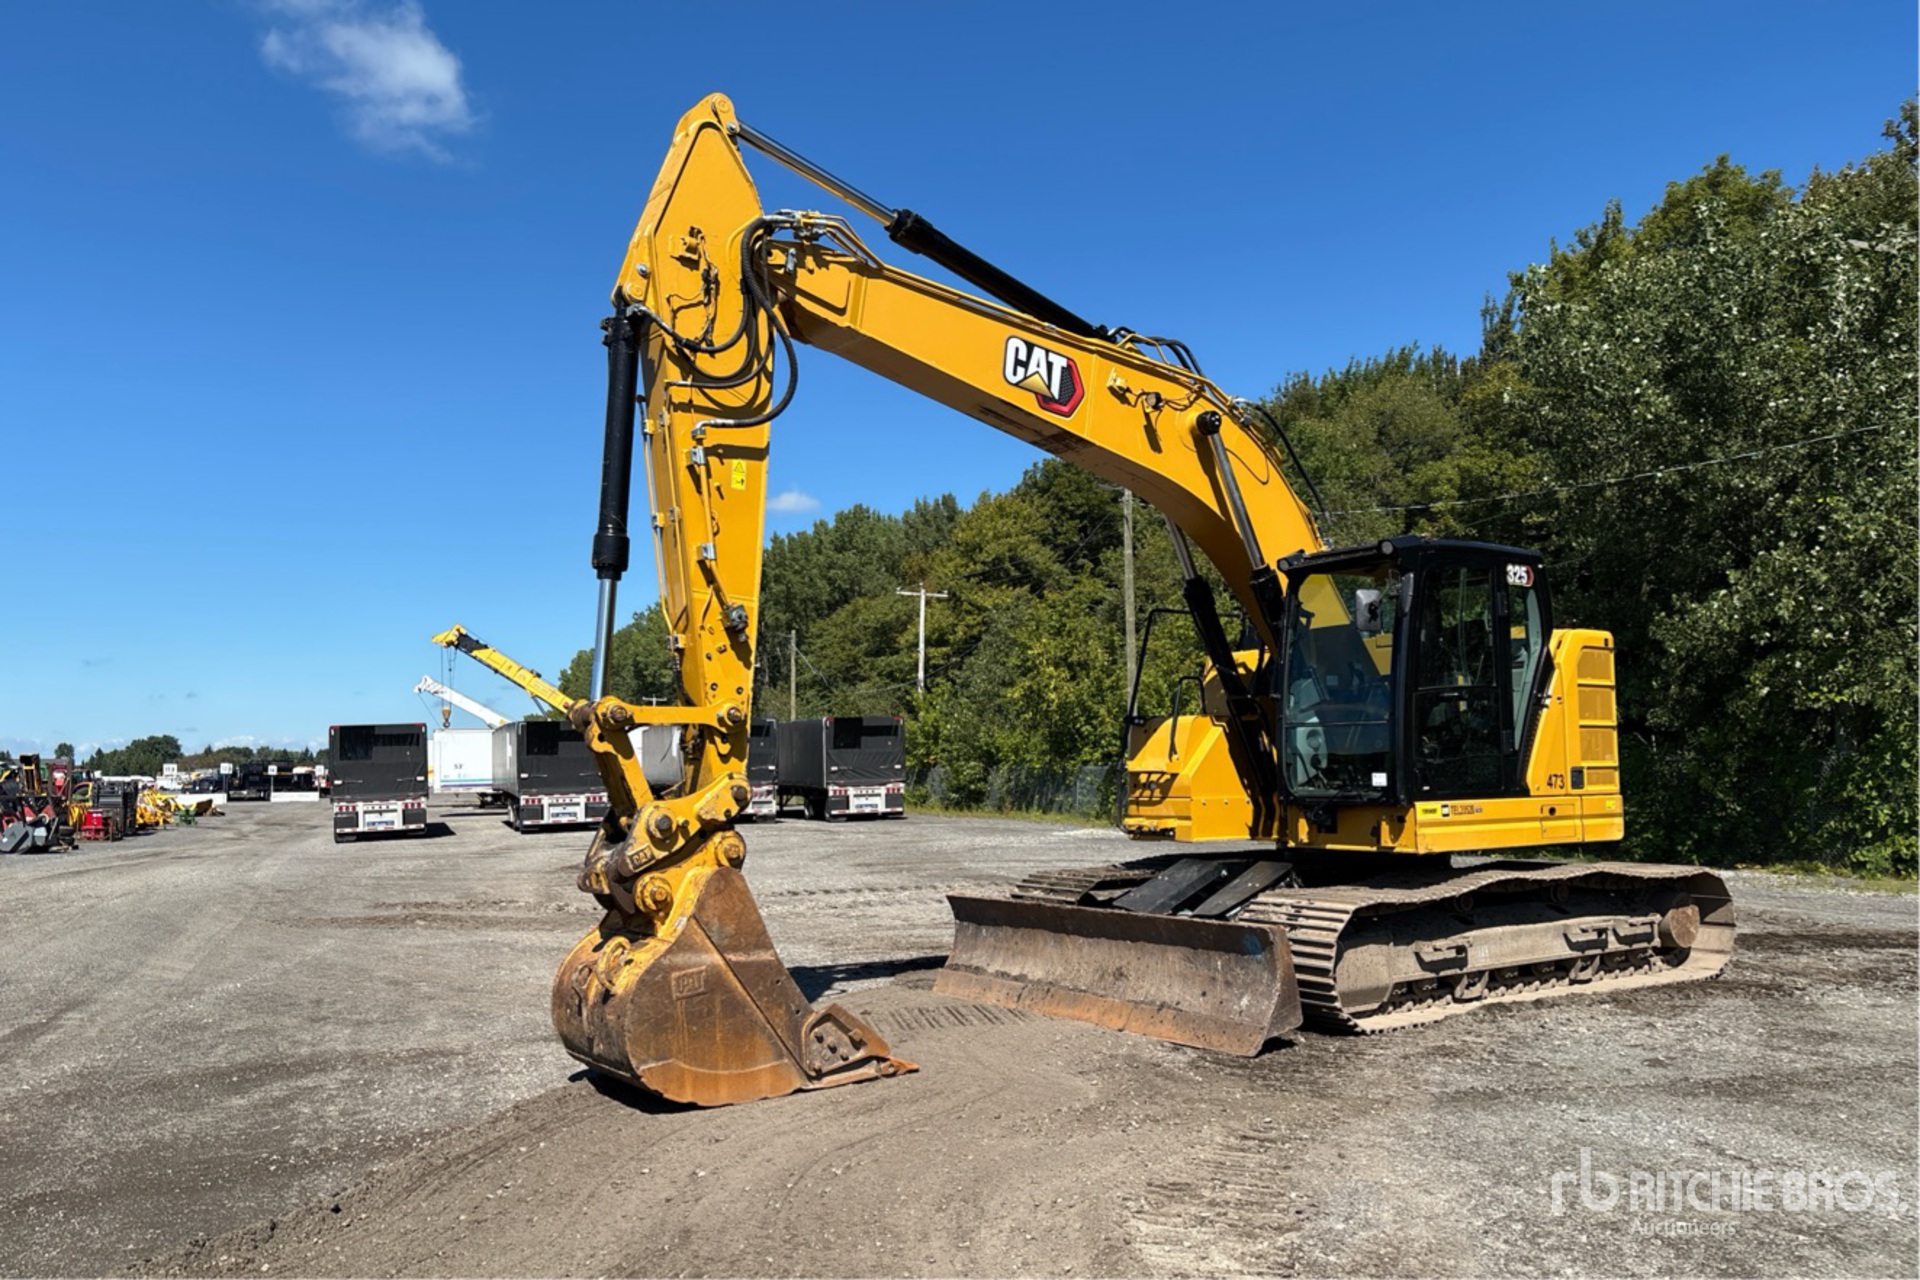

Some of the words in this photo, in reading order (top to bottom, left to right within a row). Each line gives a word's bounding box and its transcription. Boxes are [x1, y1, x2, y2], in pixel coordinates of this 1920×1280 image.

[1005, 337, 1067, 400] CAT
[1507, 563, 1528, 583] 325
[1547, 774, 1565, 791] 473
